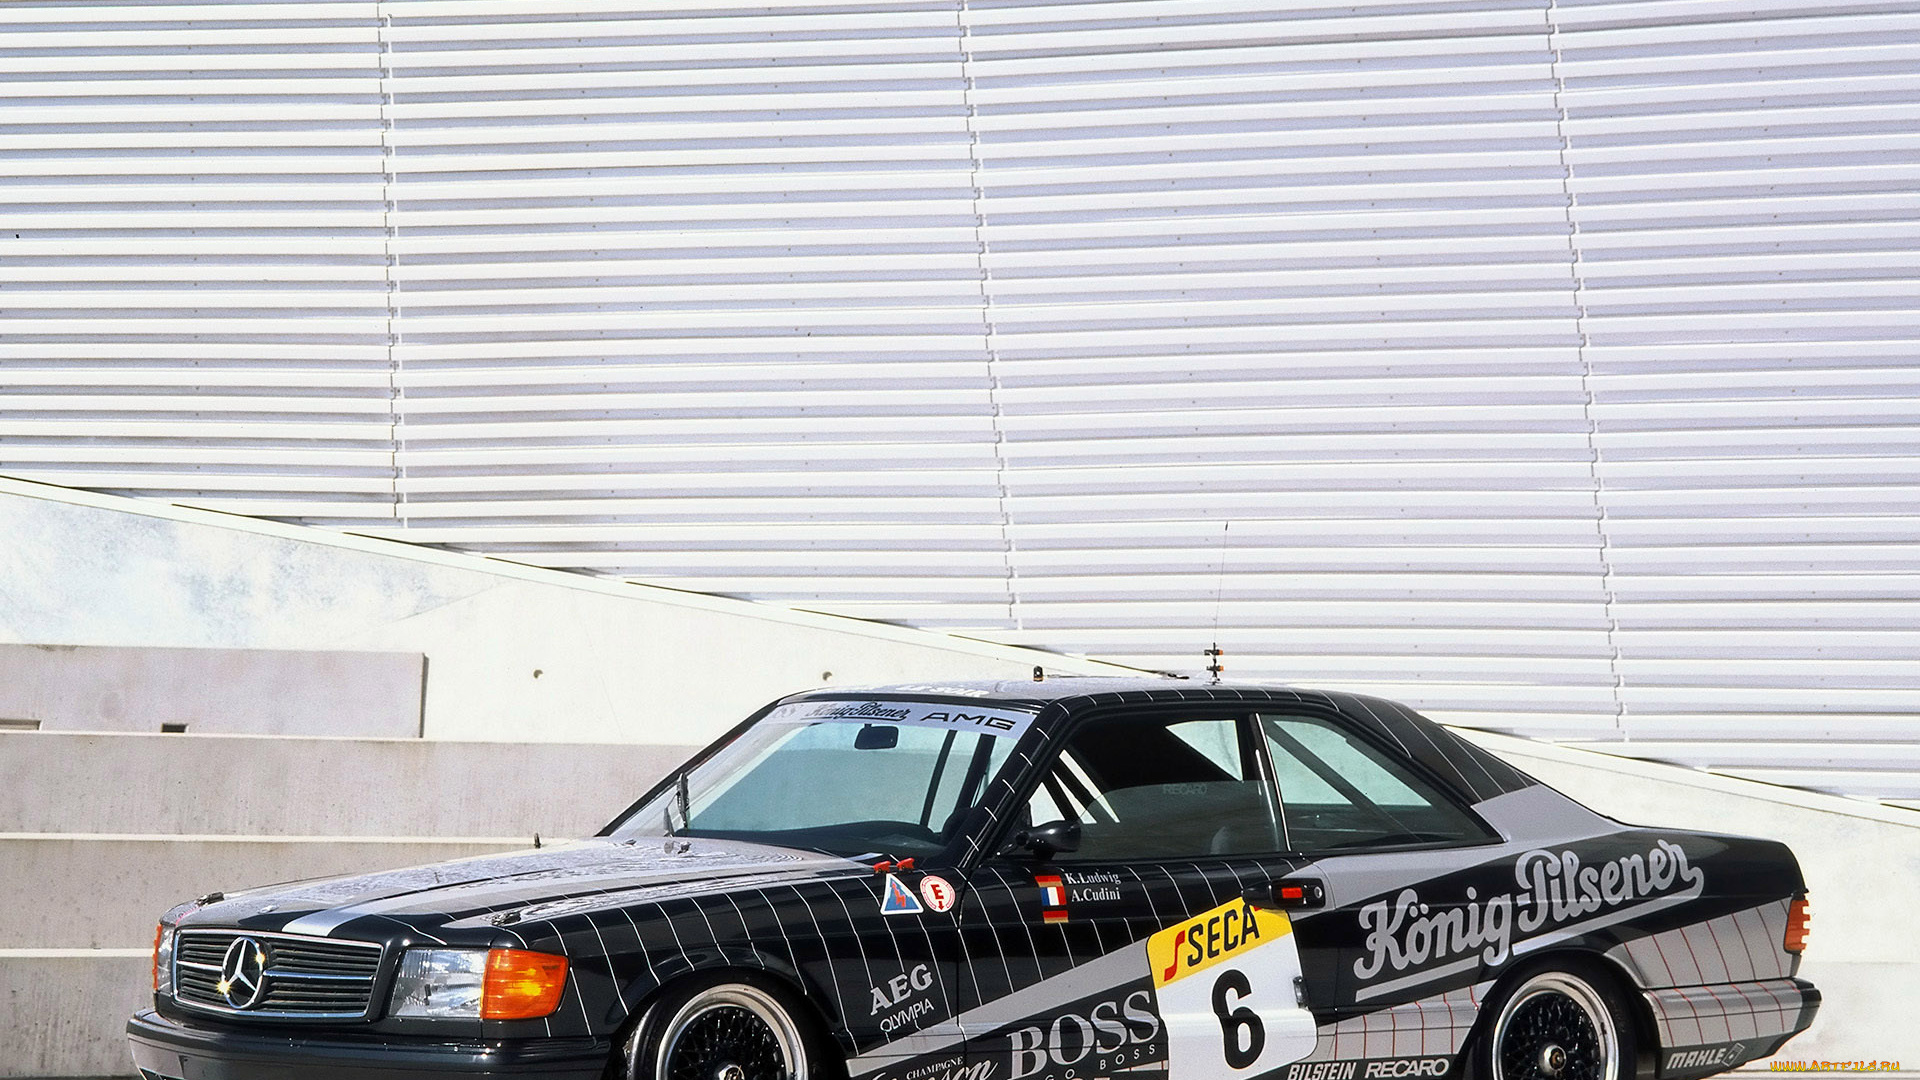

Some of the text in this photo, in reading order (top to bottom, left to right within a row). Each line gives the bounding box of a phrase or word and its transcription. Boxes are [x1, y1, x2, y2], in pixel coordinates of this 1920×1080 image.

[920, 712, 1016, 731] AMG
[1065, 871, 1121, 885] K.Ludwig
[930, 884, 944, 900] E
[1071, 887, 1121, 902] A.Cudini
[1187, 903, 1260, 967] SECA
[870, 964, 933, 1016] AEG
[880, 998, 934, 1032] OLYMPIA
[1211, 969, 1266, 1070] 6
[1006, 990, 1159, 1080] BOSS
[906, 1056, 964, 1080] CHAMPAGNE
[1100, 1044, 1155, 1070] BOSS
[1287, 1058, 1449, 1080] BILSTEIN RECARO
[1666, 1048, 1727, 1070] MAHLE
